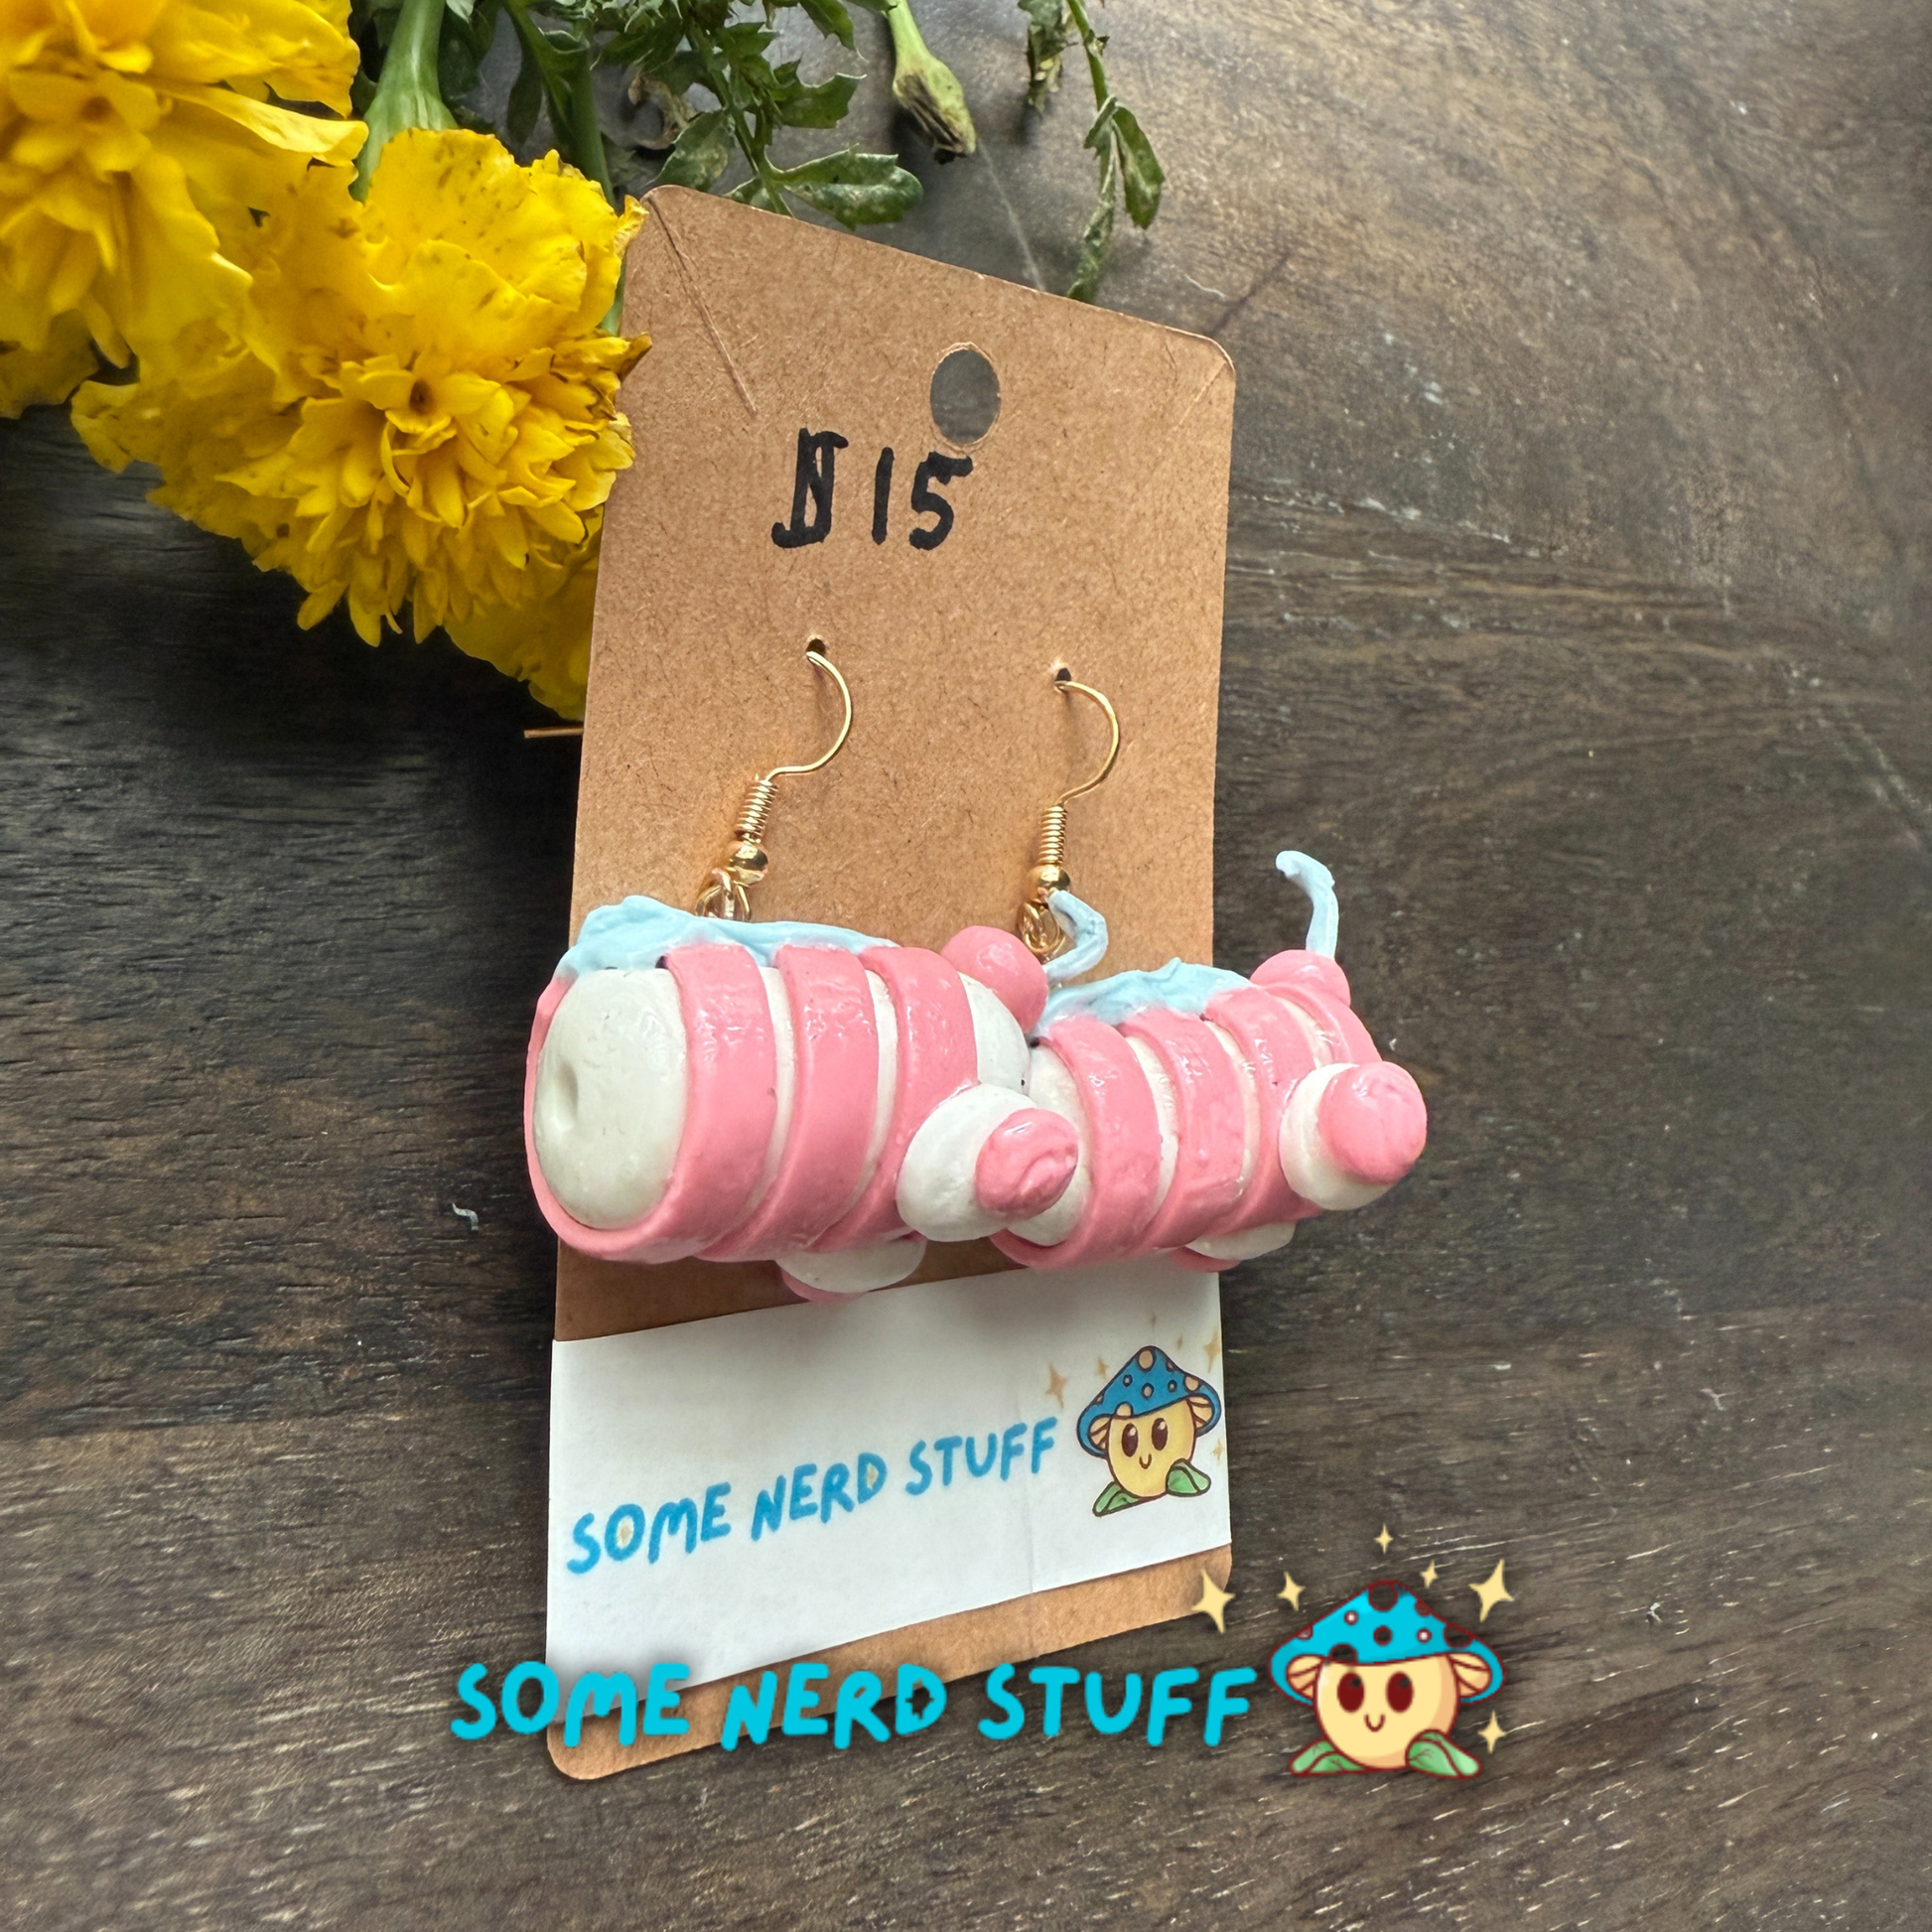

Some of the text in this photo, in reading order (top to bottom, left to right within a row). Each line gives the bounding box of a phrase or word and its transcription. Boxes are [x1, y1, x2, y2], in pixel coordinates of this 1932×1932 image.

[566, 1416, 1058, 1575] SOME NERD STUFF
